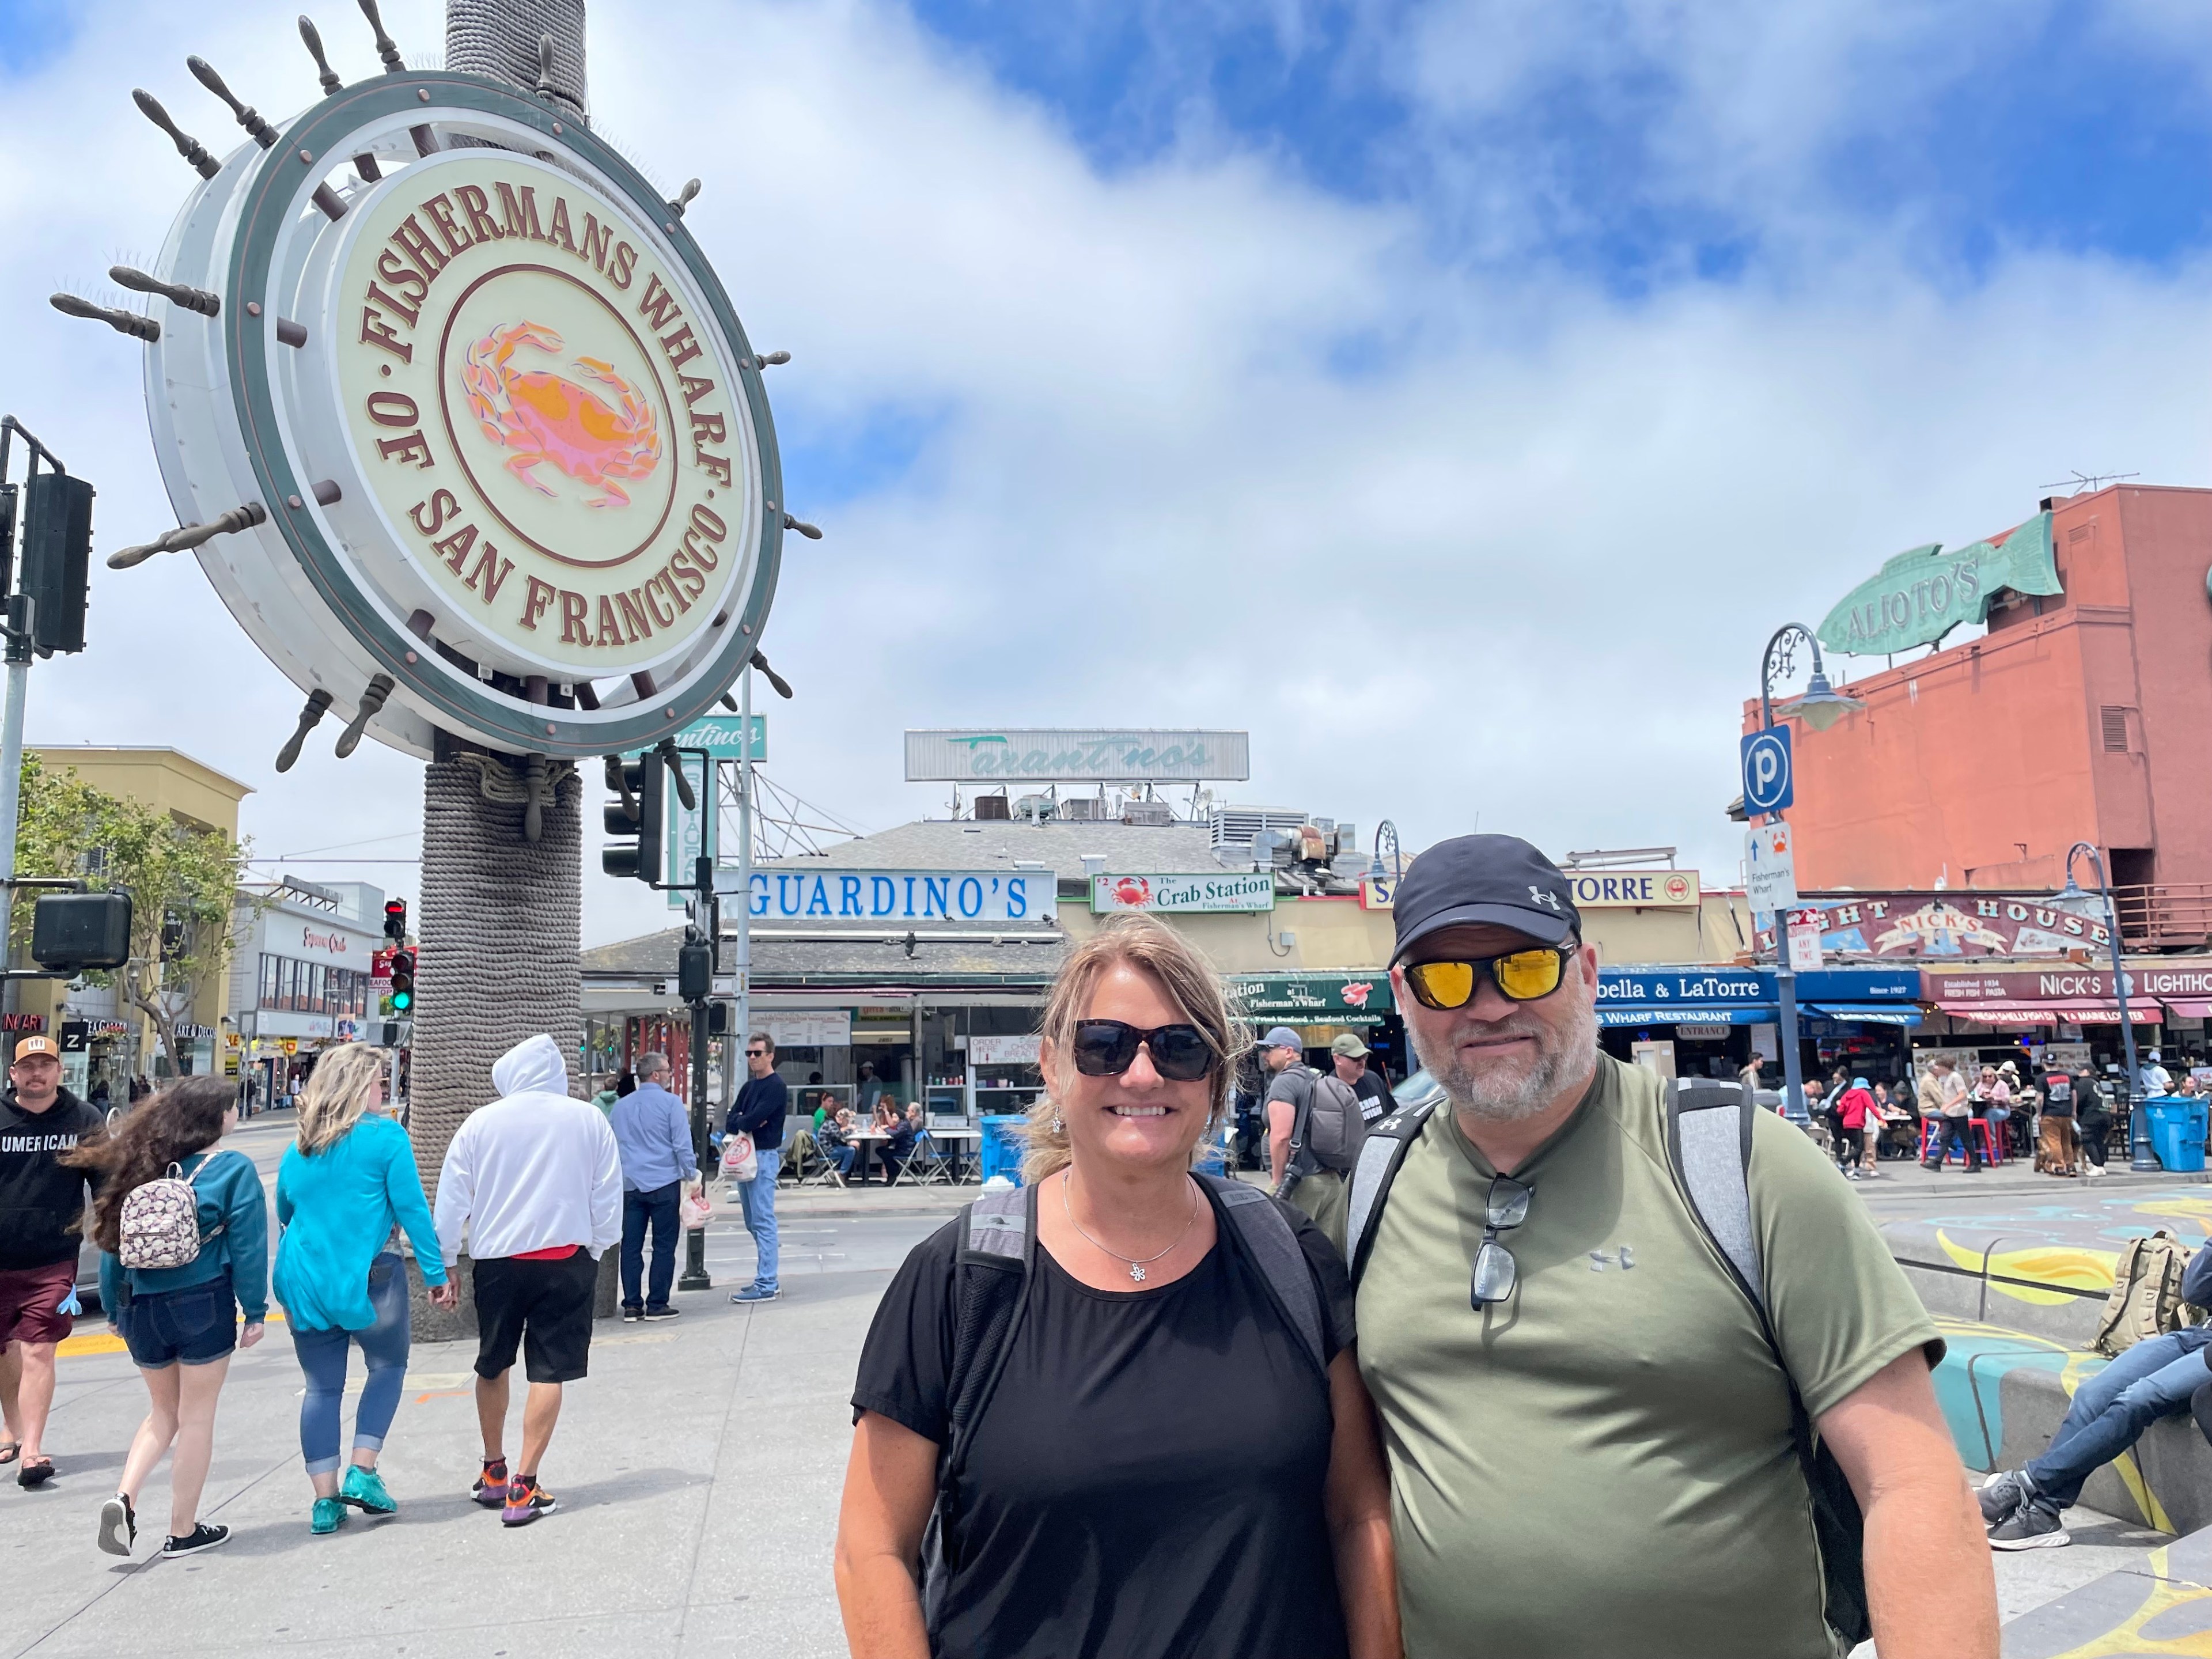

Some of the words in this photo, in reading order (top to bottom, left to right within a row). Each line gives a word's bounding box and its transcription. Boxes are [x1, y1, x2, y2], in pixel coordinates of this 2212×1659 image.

[358, 180, 639, 364] FISHERMANS
[637, 271, 732, 488] WHARF
[366, 391, 437, 471] OF
[408, 487, 514, 606] SAN
[517, 503, 728, 647] FRANCISCO
[1846, 559, 1979, 642] ALIOTO'S
[1752, 868, 1790, 882] Fisherman's
[1157, 884, 1200, 906] Crab
[1206, 877, 1270, 900] Station
[1567, 878, 1653, 901] TORRE
[1753, 882, 1772, 894] Wharf
[748, 873, 1027, 918] GUARDINO'S
[1899, 914, 1978, 934] NICK'S
[1976, 899, 2111, 946] HOUSE
[1799, 939, 1810, 948] ANY
[1798, 950, 1813, 960] TIME
[1656, 983, 1669, 998] &
[1679, 978, 1760, 997] LaTorre
[1985, 987, 2006, 997] PASTA
[2040, 974, 2102, 997] NICK'S
[1250, 999, 1300, 1007] Fisherman's
[1301, 998, 1326, 1007] Wharf
[1346, 1014, 1382, 1022] Cocktails
[1605, 1012, 1652, 1024] WHARF
[1654, 1011, 1732, 1022] RESTAURANT
[176, 1024, 190, 1037] ART
[191, 1024, 196, 1037] &
[1680, 1025, 1726, 1036] ENTRANCE
[67, 1034, 79, 1048] Z
